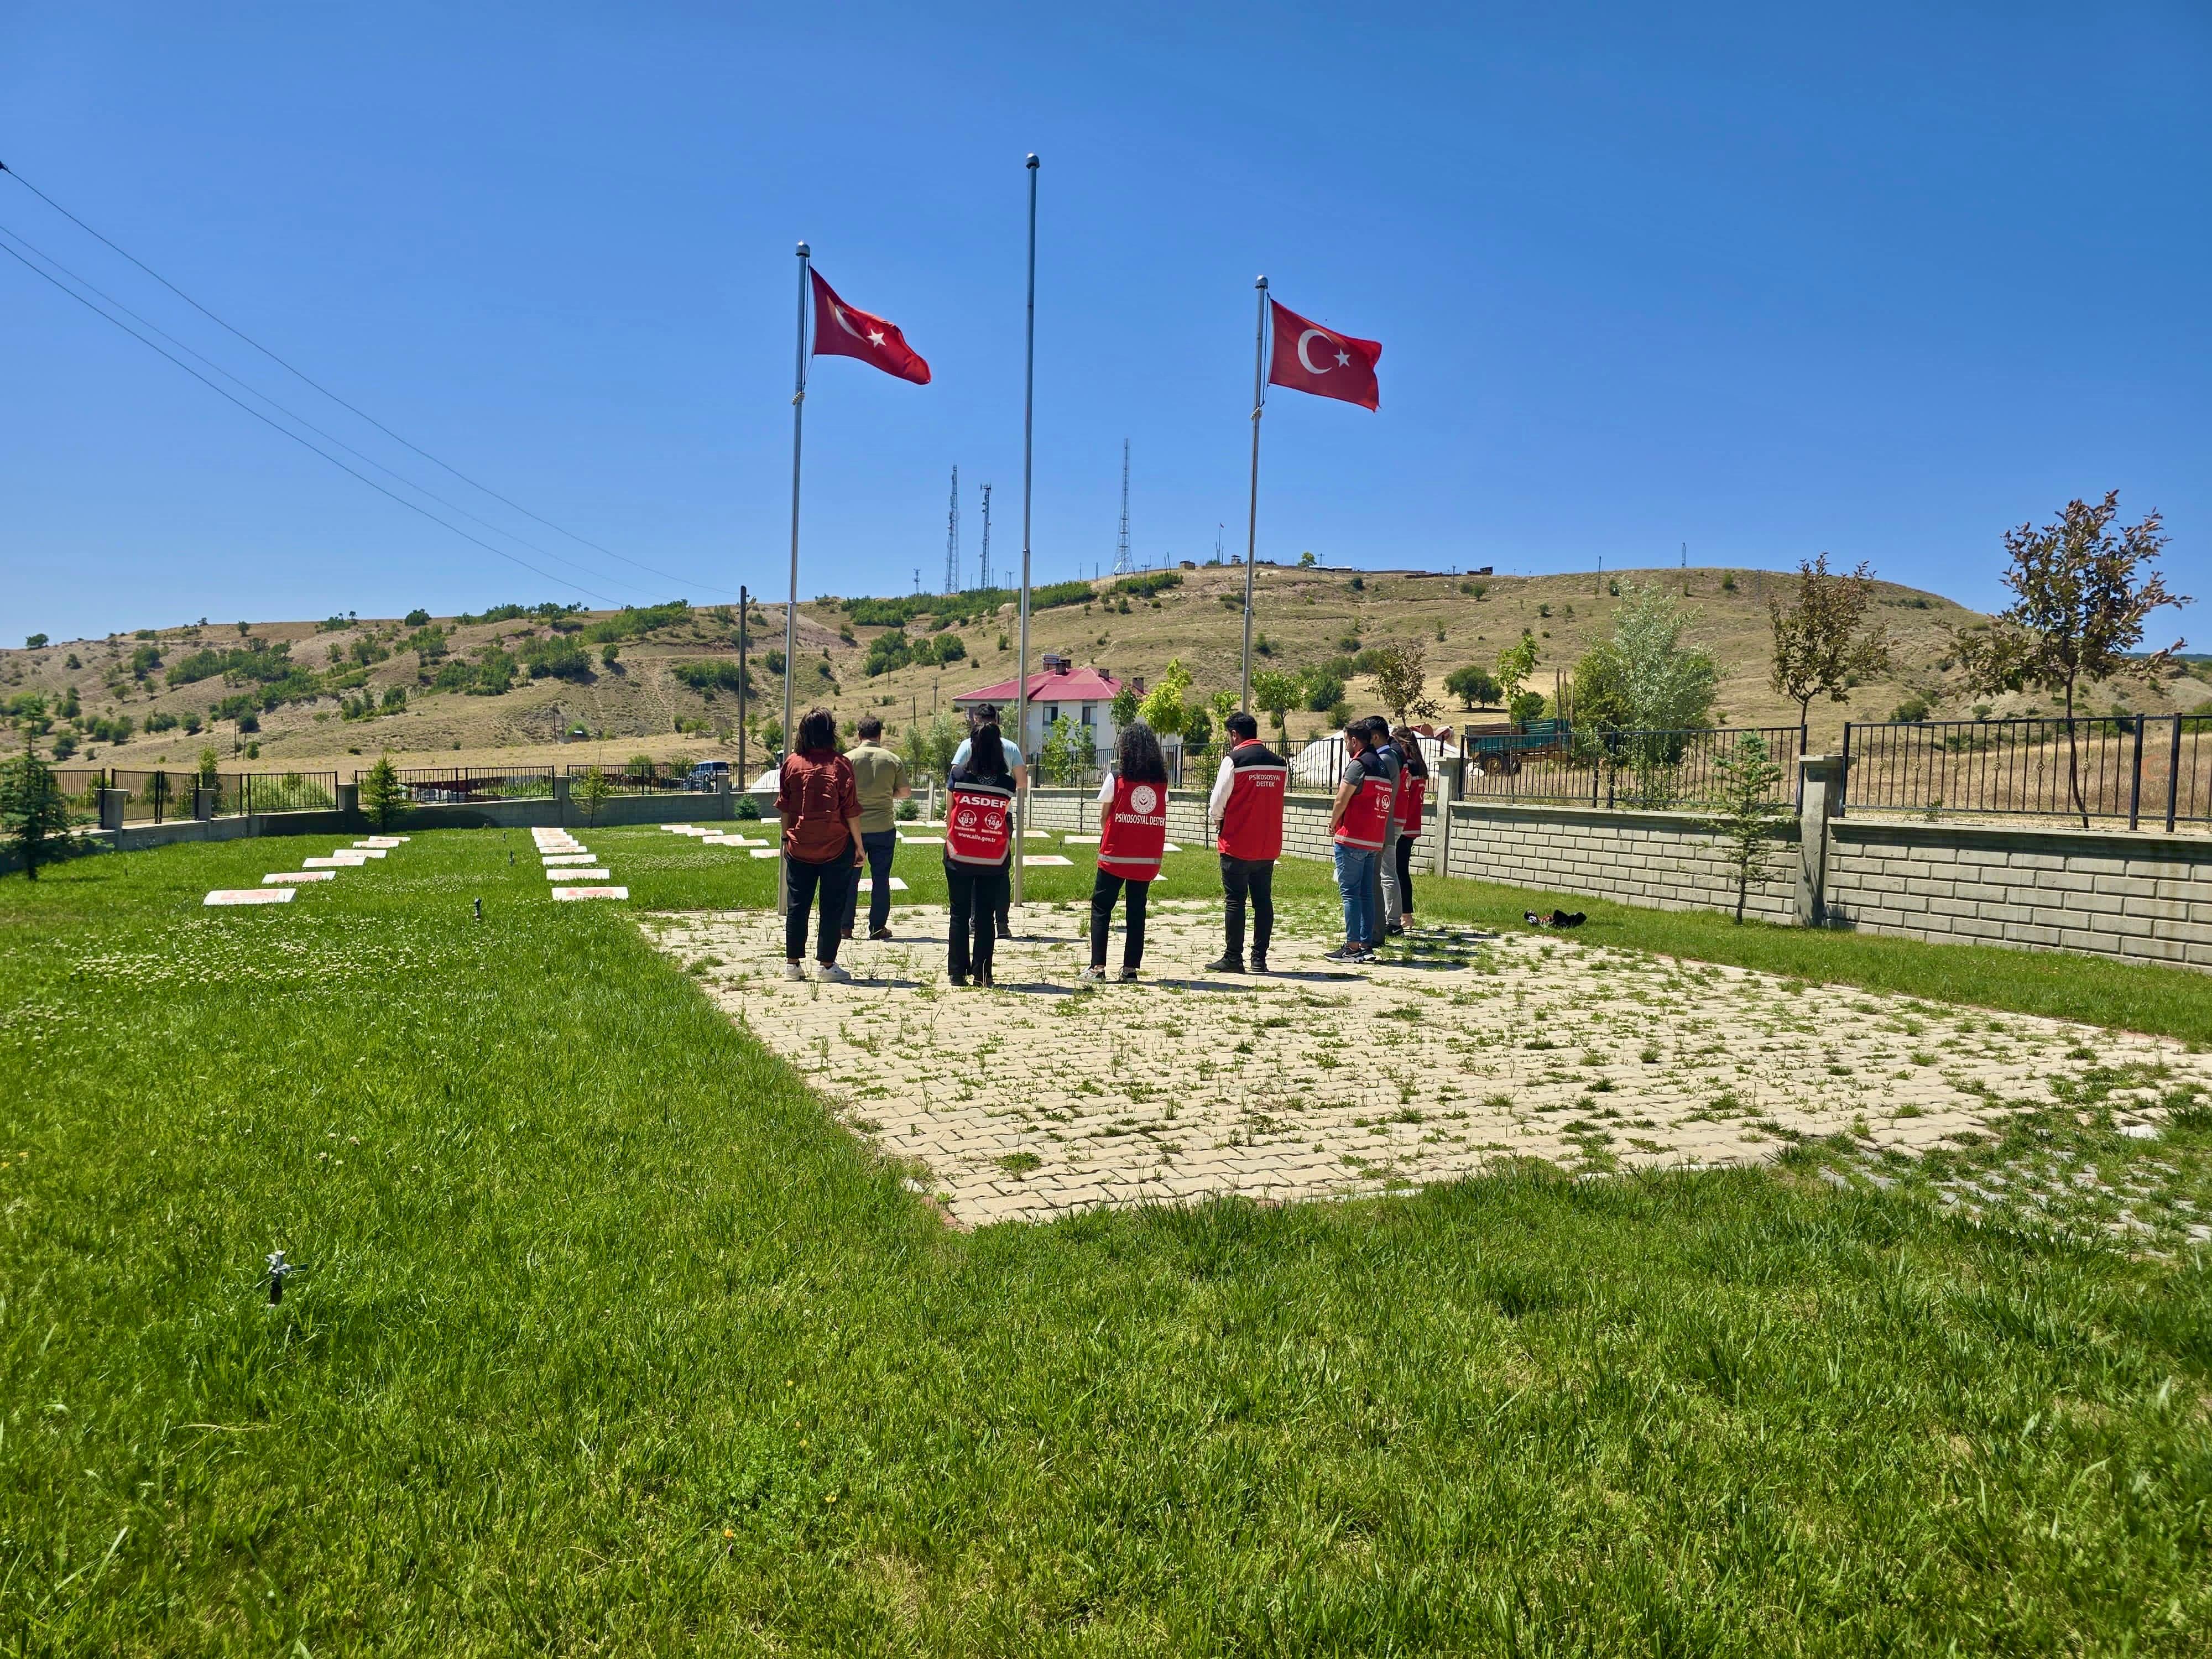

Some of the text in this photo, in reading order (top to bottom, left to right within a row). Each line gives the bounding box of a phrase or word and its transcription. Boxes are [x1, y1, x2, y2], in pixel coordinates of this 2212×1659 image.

[959, 796, 1006, 808] ASDEP
[1115, 812, 1165, 827] PSİKOSOSYAL DESTEK
